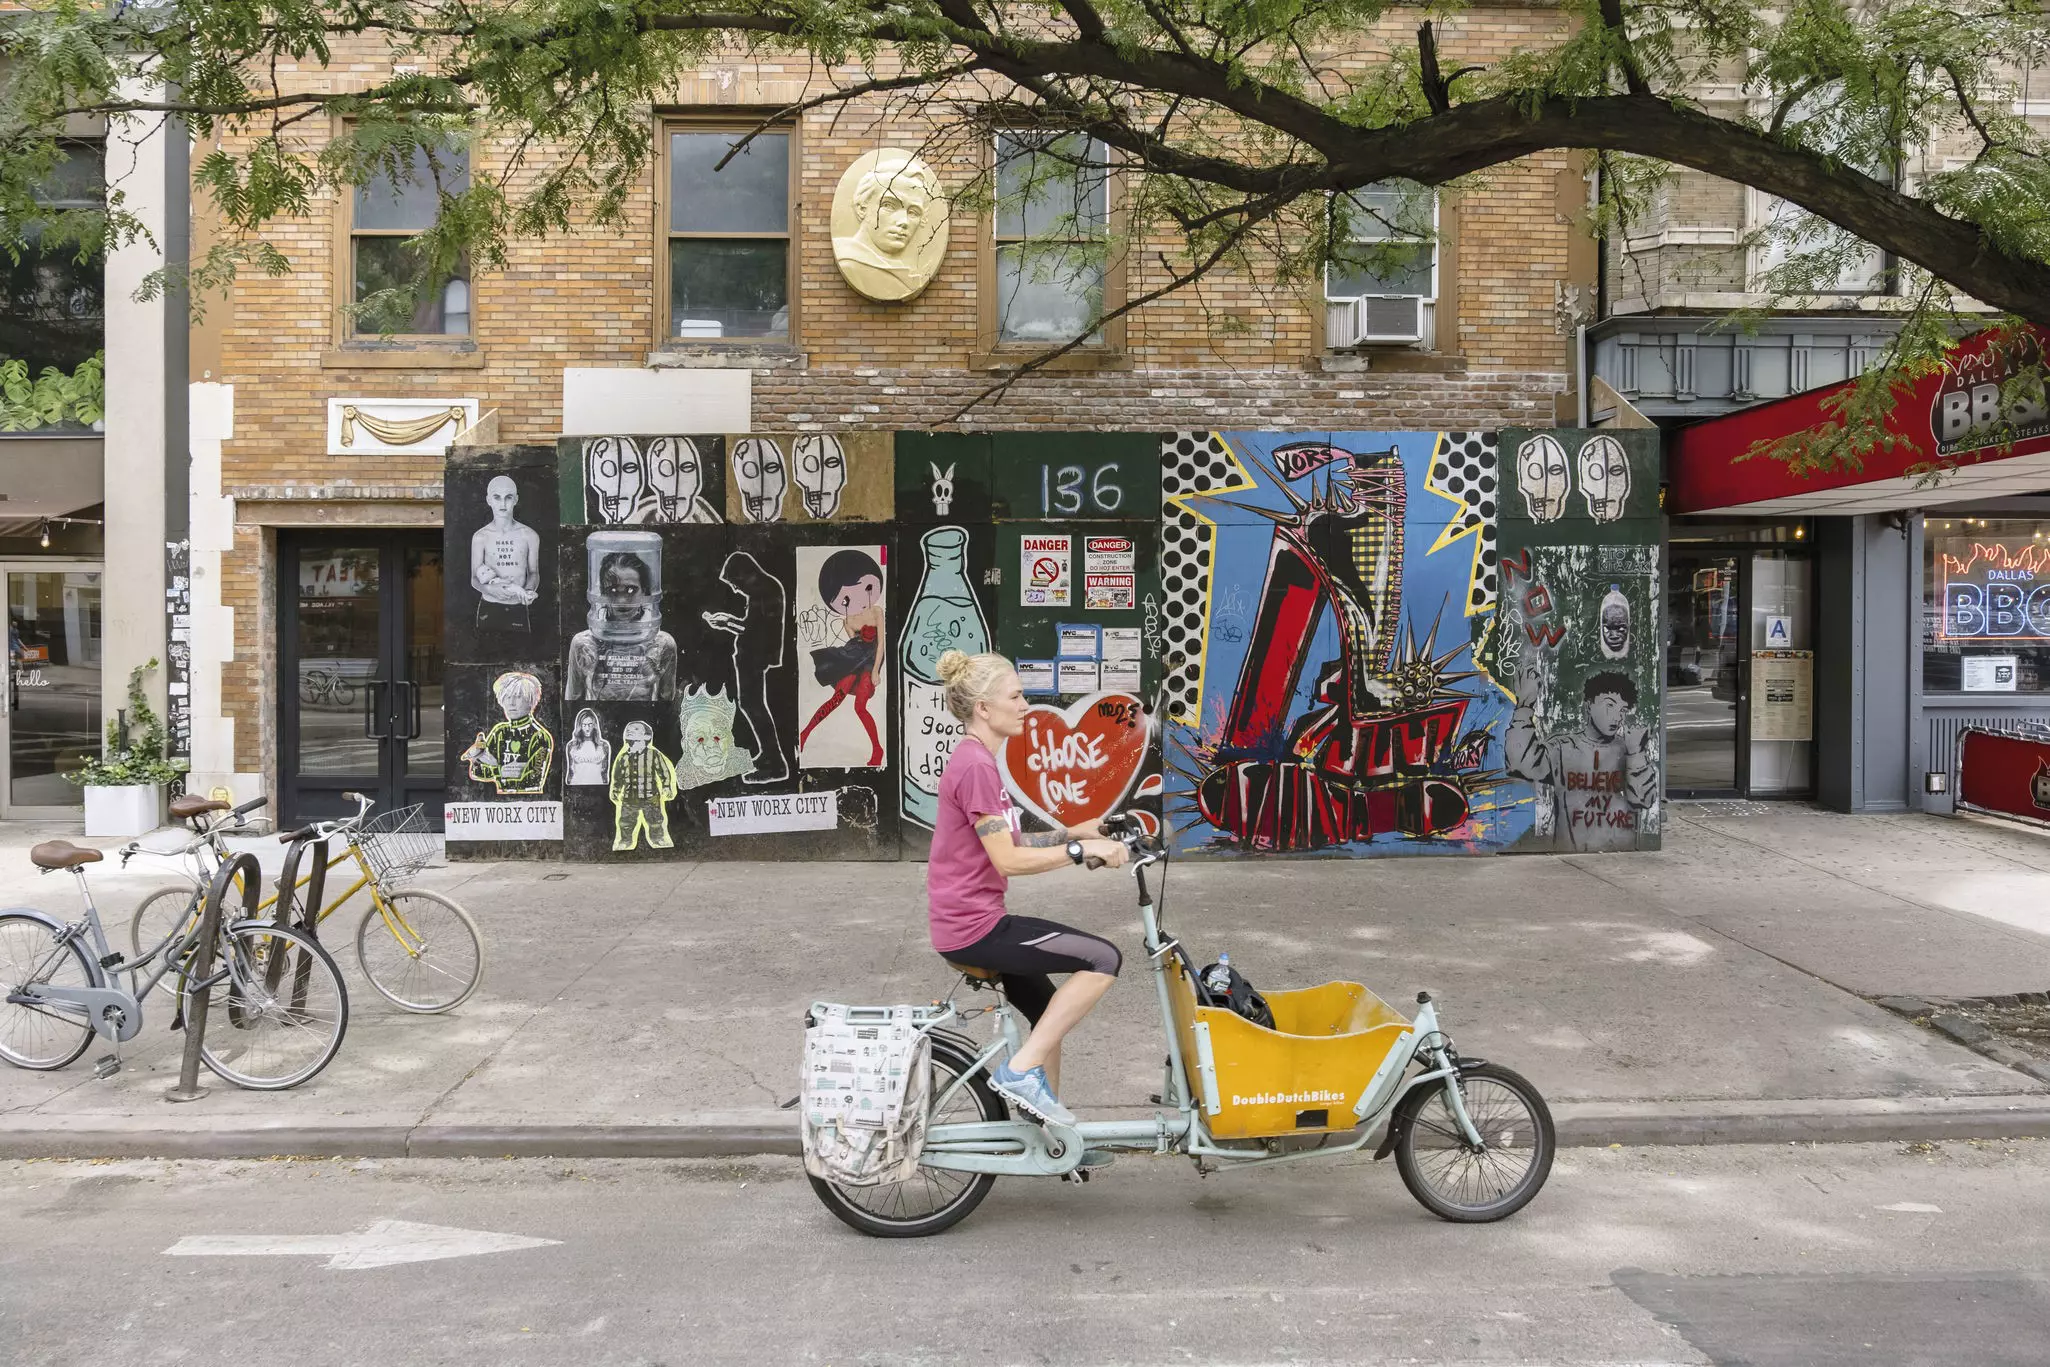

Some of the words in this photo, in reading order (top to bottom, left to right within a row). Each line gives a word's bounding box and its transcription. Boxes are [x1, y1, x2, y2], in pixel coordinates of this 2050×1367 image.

[2016, 424, 2049, 438] STEAKS
[1041, 463, 1123, 513] 136
[1024, 539, 1068, 550] DANGER
[1092, 541, 1127, 549] DANGER
[1088, 576, 1131, 586] WARNING
[1988, 569, 2034, 580] DALLAS
[1770, 619, 1787, 638] A
[16, 670, 50, 686] hello
[505, 739, 511, 752] I
[1027, 728, 1109, 772] CHOOSE
[503, 752, 521, 765] NY
[1594, 751, 1599, 770] I
[1567, 772, 1623, 793] BELIEVE
[752, 798, 791, 817] WORX
[796, 796, 828, 814] CITY
[1585, 795, 1612, 813] MY
[486, 807, 522, 823] WORX
[527, 806, 557, 823] CITY
[1571, 810, 1634, 829] FUTURE
[1232, 1090, 1345, 1106] DoubleDutchBikes
